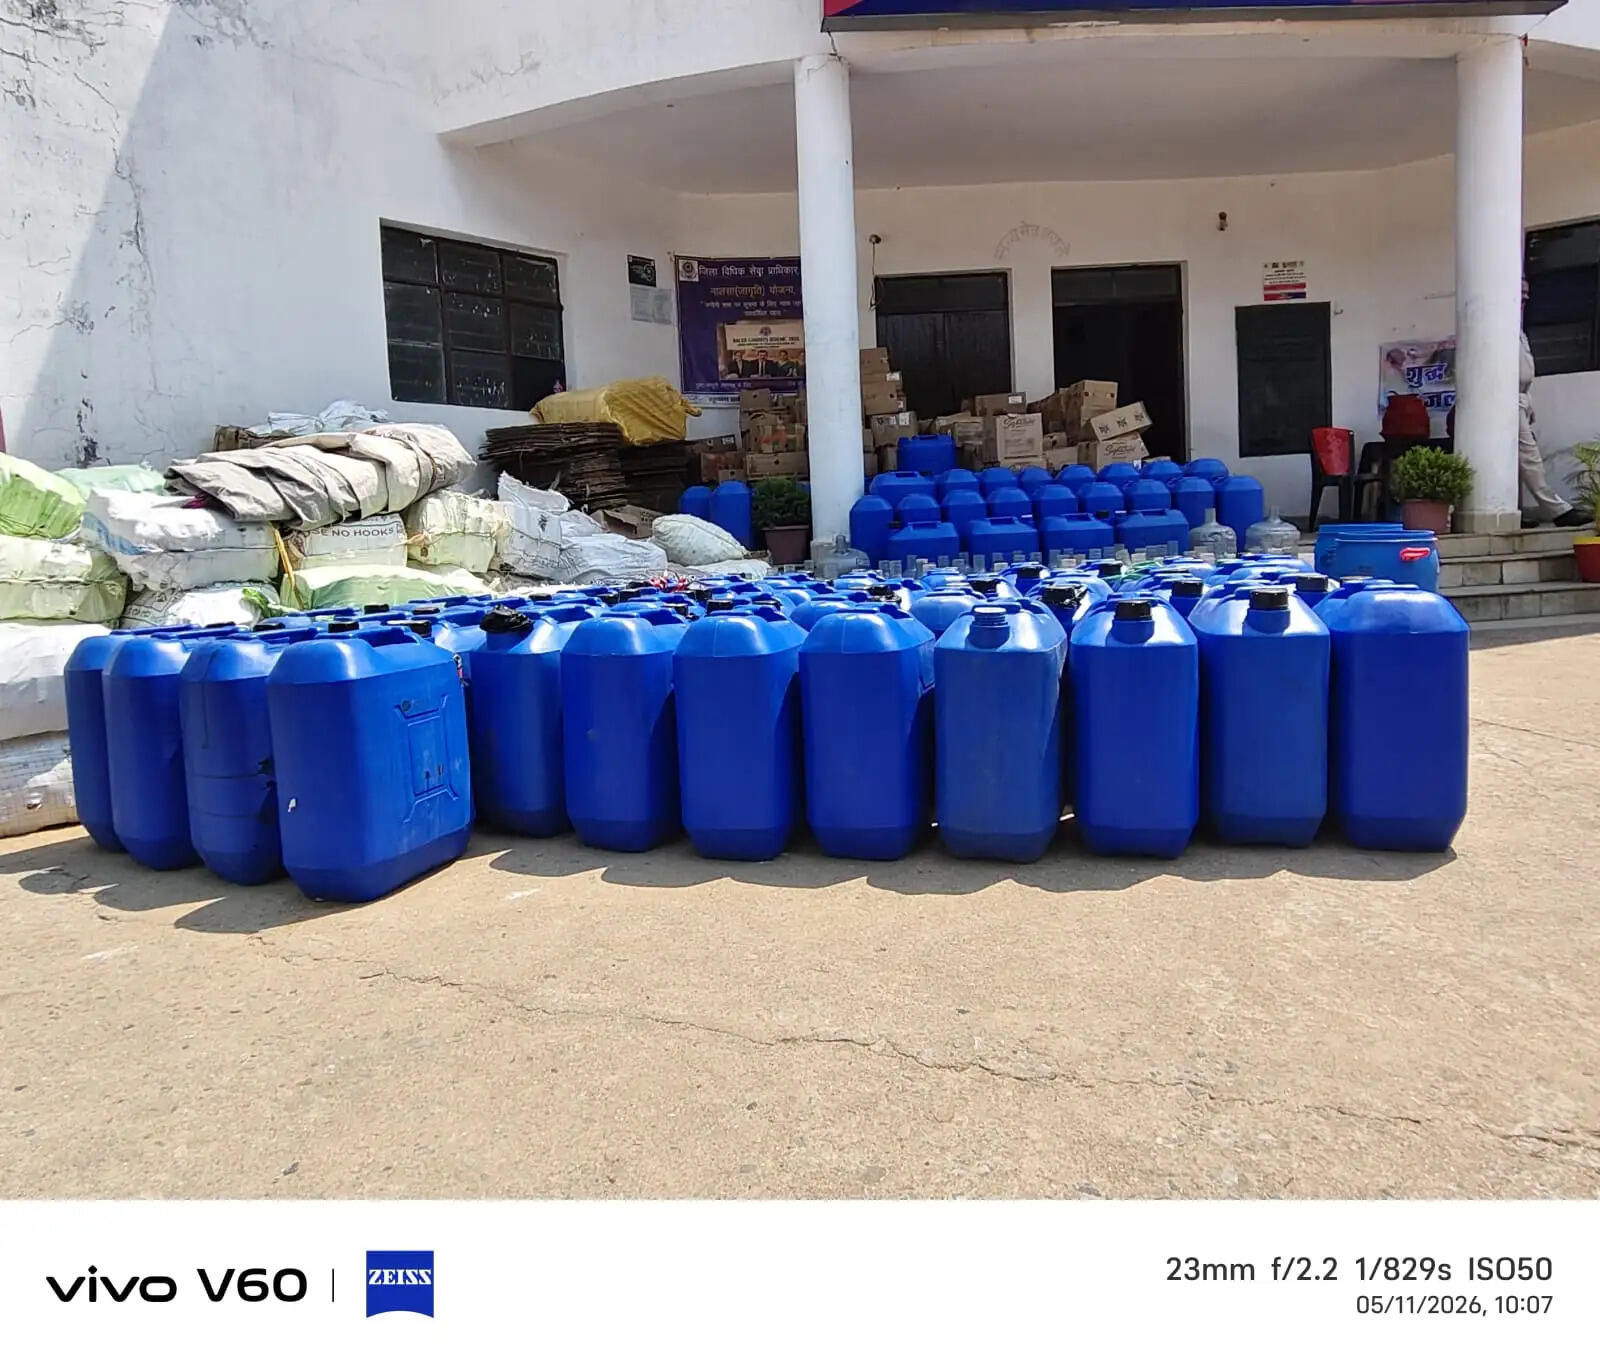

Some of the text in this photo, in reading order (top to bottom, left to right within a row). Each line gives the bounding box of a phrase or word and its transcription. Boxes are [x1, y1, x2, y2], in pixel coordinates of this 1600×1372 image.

[699, 264, 718, 276] जिला
[722, 265, 745, 277] विधिक
[749, 265, 764, 277] सेवा
[332, 529, 350, 537] NO
[354, 527, 393, 537] HOOKS
